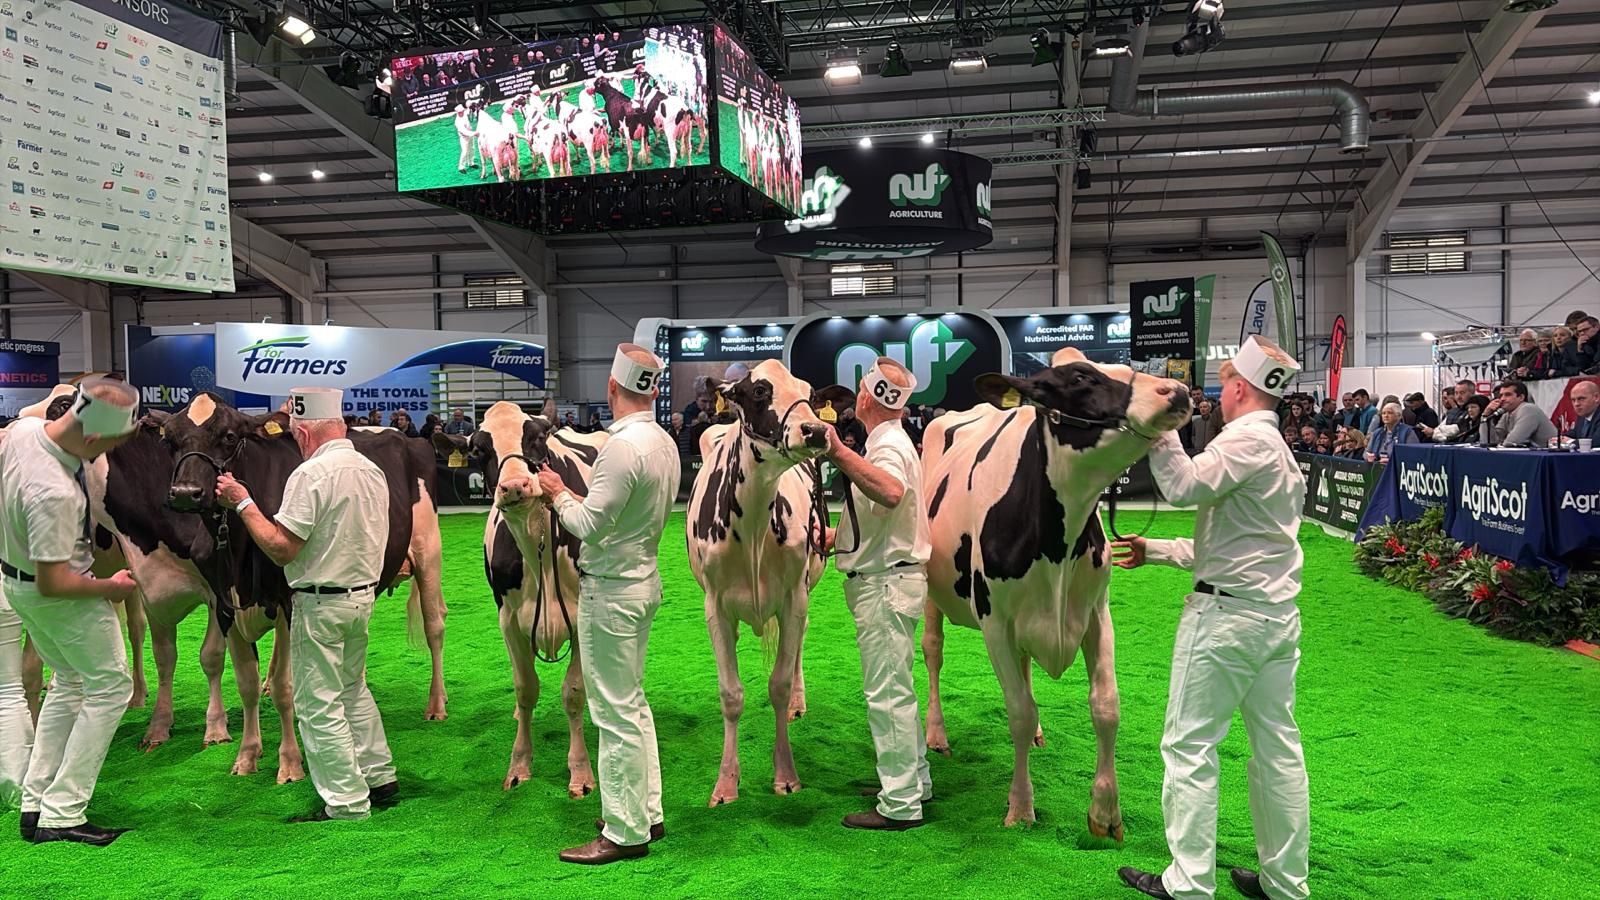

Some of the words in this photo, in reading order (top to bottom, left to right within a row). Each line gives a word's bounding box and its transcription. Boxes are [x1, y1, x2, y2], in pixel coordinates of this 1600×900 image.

[112, 0, 168, 24] NSORS
[17, 139, 44, 154] Farmer
[889, 162, 950, 200] nwf
[889, 209, 943, 219] AGRICULTURE
[815, 240, 944, 249] AGRICULTURE
[1142, 318, 1182, 327] AGRICULTURE
[1036, 324, 1078, 334] Accredited
[720, 335, 755, 344] Ruminant
[756, 335, 783, 344] Experts
[1024, 335, 1067, 343] Nutritional
[1067, 334, 1094, 342] Advice
[1163, 331, 1189, 339] SUPPLIER
[15, 343, 45, 353] progress
[264, 347, 285, 358] for
[721, 344, 755, 353] Providing
[242, 339, 348, 382] farmers
[491, 345, 543, 368] farmers
[0, 372, 48, 383] NETICS
[351, 388, 379, 398] THE
[382, 388, 429, 398] TOTAL
[873, 379, 902, 406] 63
[357, 401, 429, 412] BUSINESS
[1400, 461, 1449, 500] AgriScot
[1462, 474, 1528, 521] AgriScot
